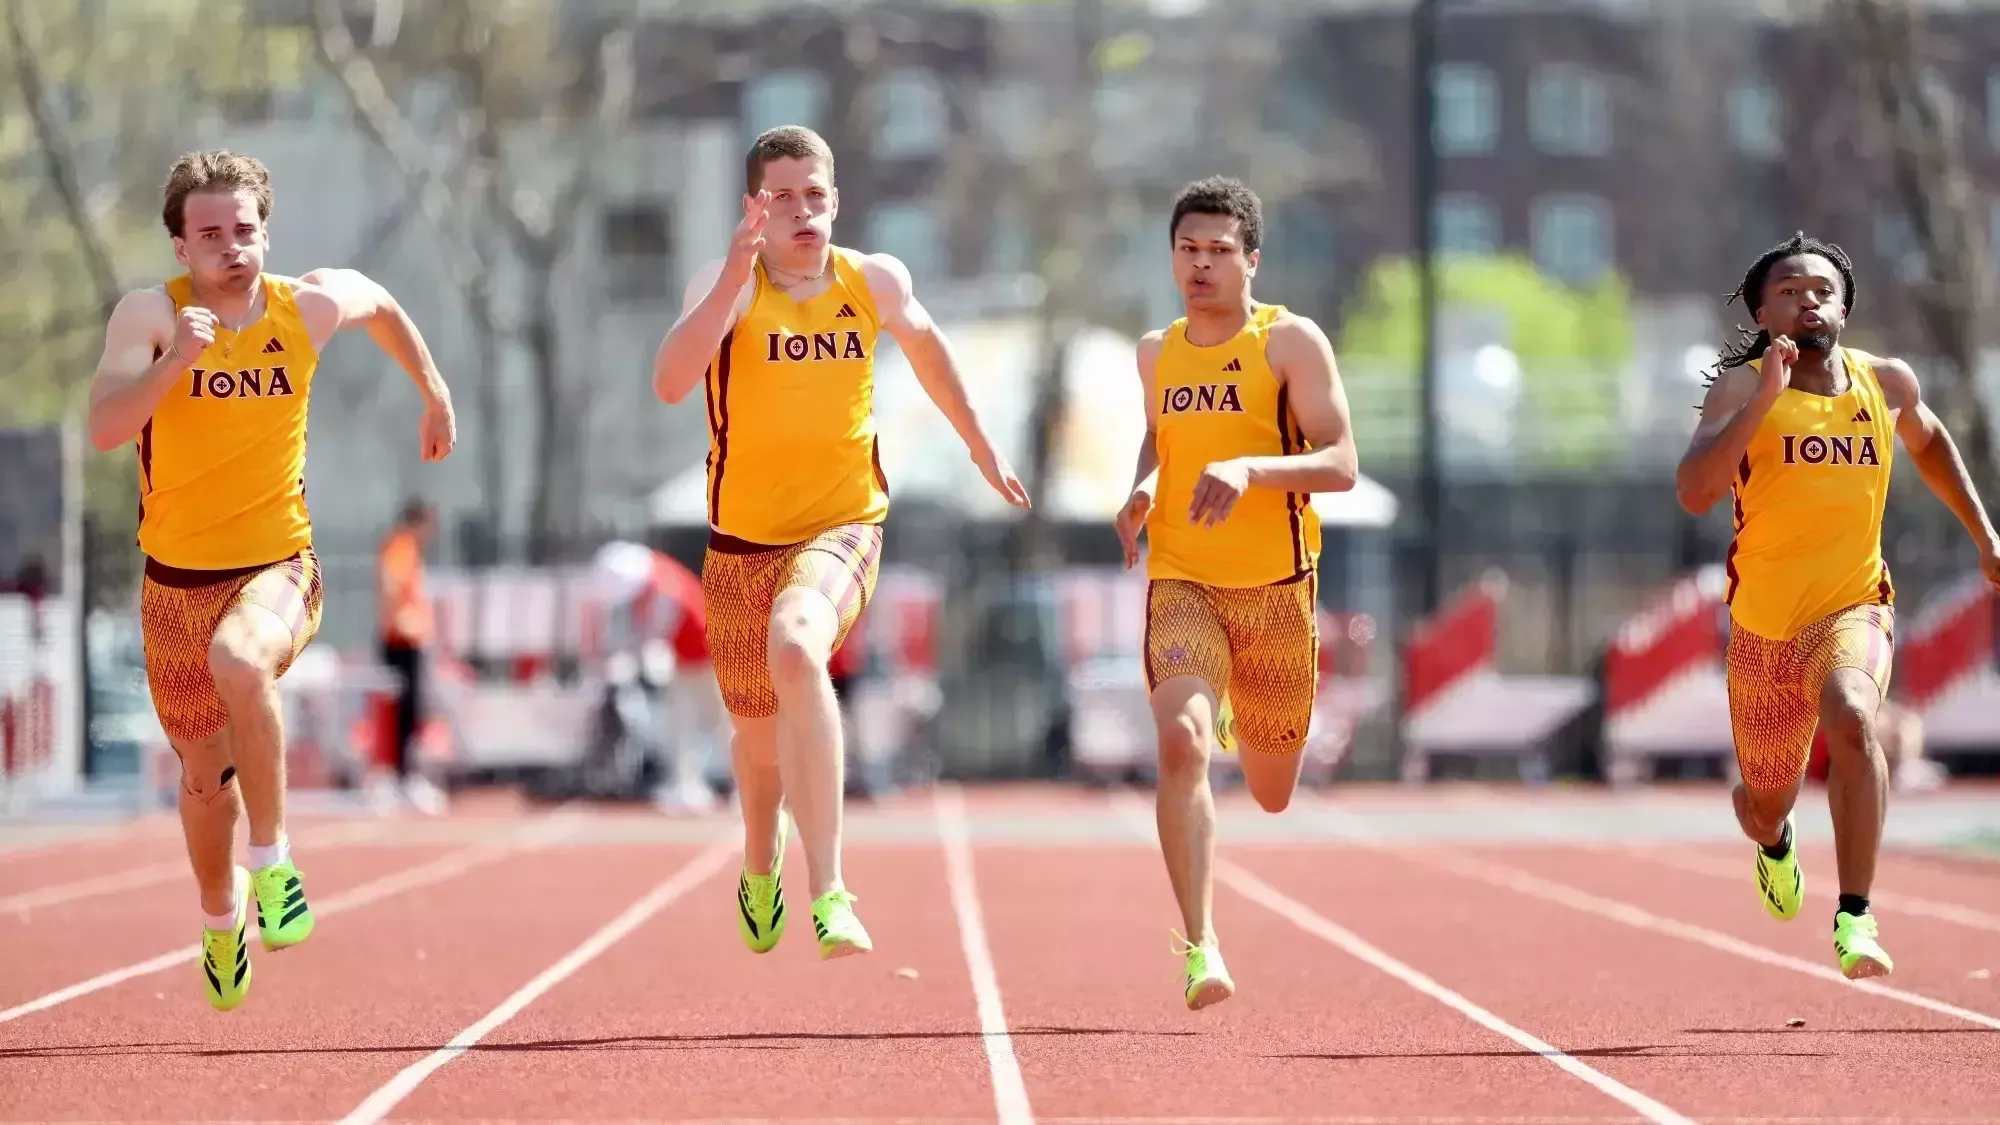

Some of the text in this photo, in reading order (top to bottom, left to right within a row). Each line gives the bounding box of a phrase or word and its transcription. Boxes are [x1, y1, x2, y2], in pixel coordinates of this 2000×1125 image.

[766, 331, 865, 362] IONA
[189, 366, 294, 398] IONA
[1162, 384, 1244, 414] IONA
[1781, 435, 1880, 465] IONA
